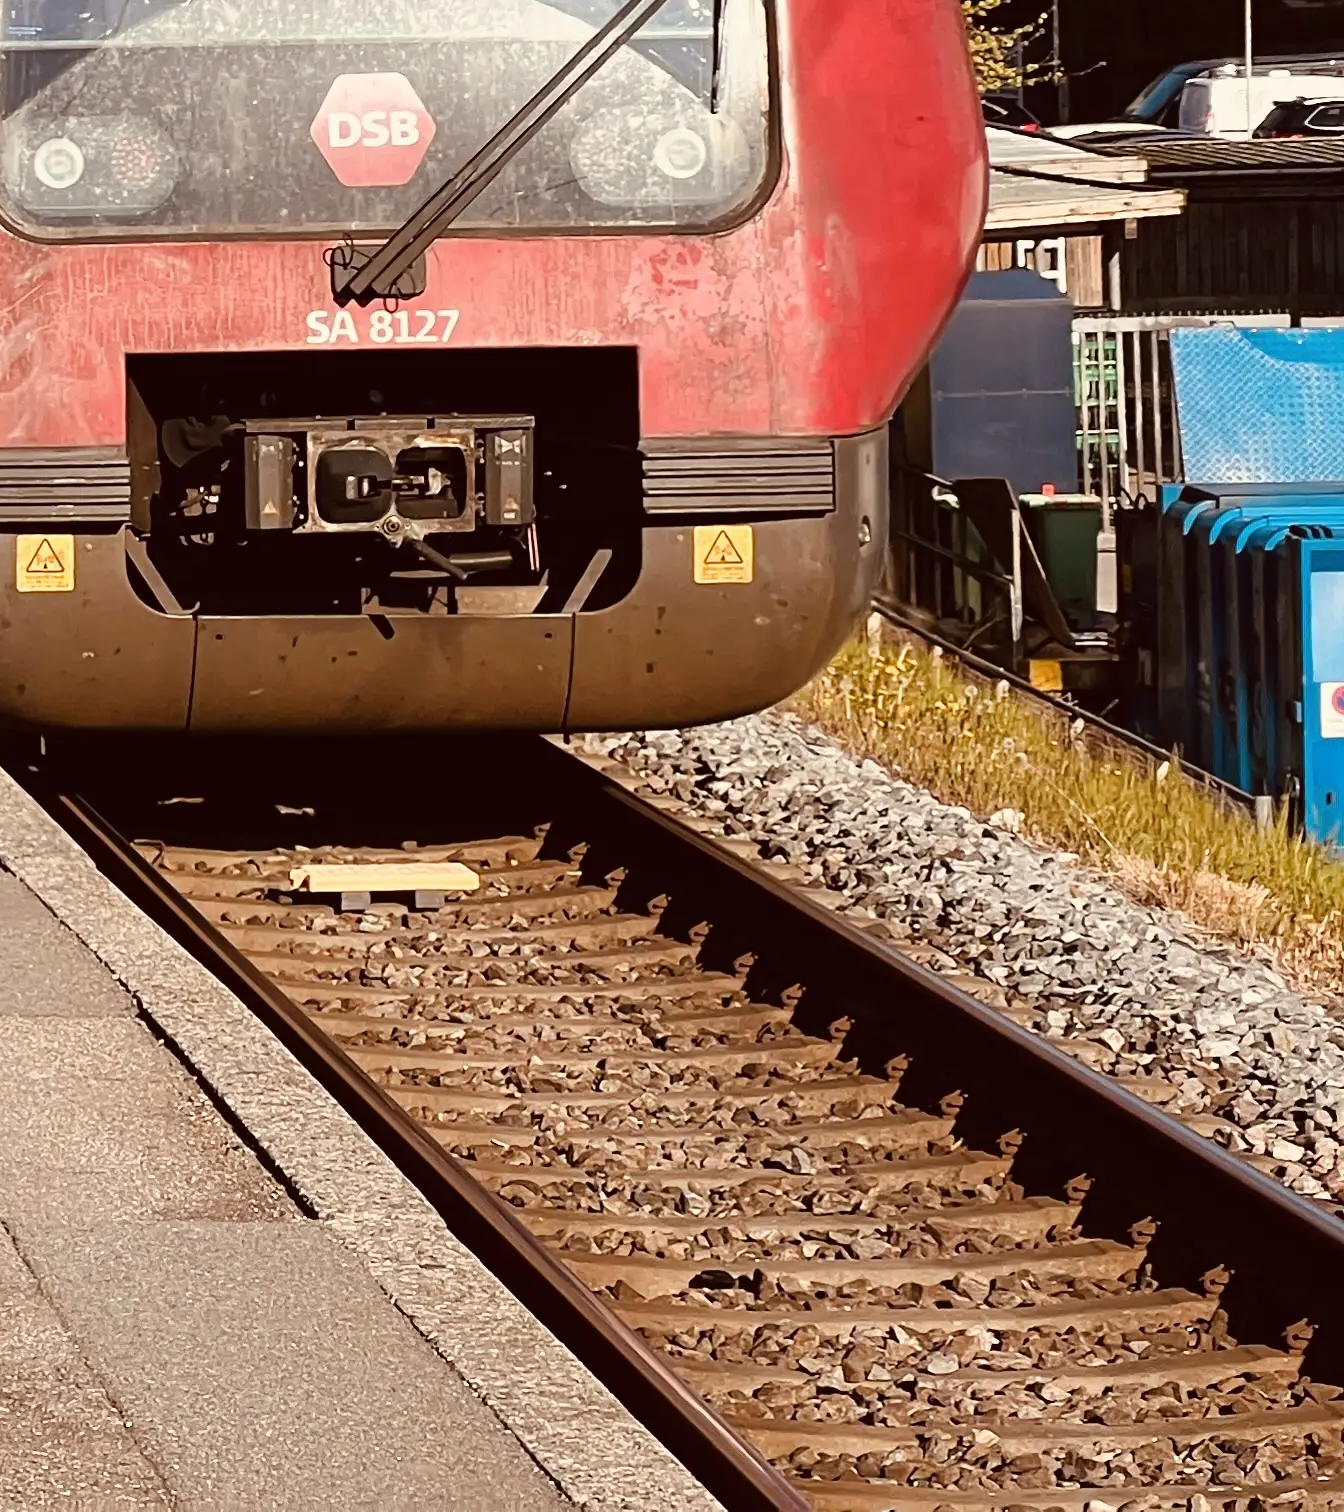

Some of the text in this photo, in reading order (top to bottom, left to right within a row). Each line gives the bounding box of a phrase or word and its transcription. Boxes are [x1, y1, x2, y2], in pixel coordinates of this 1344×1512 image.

[328, 110, 419, 148] DSB
[306, 309, 460, 344] SA 8127
